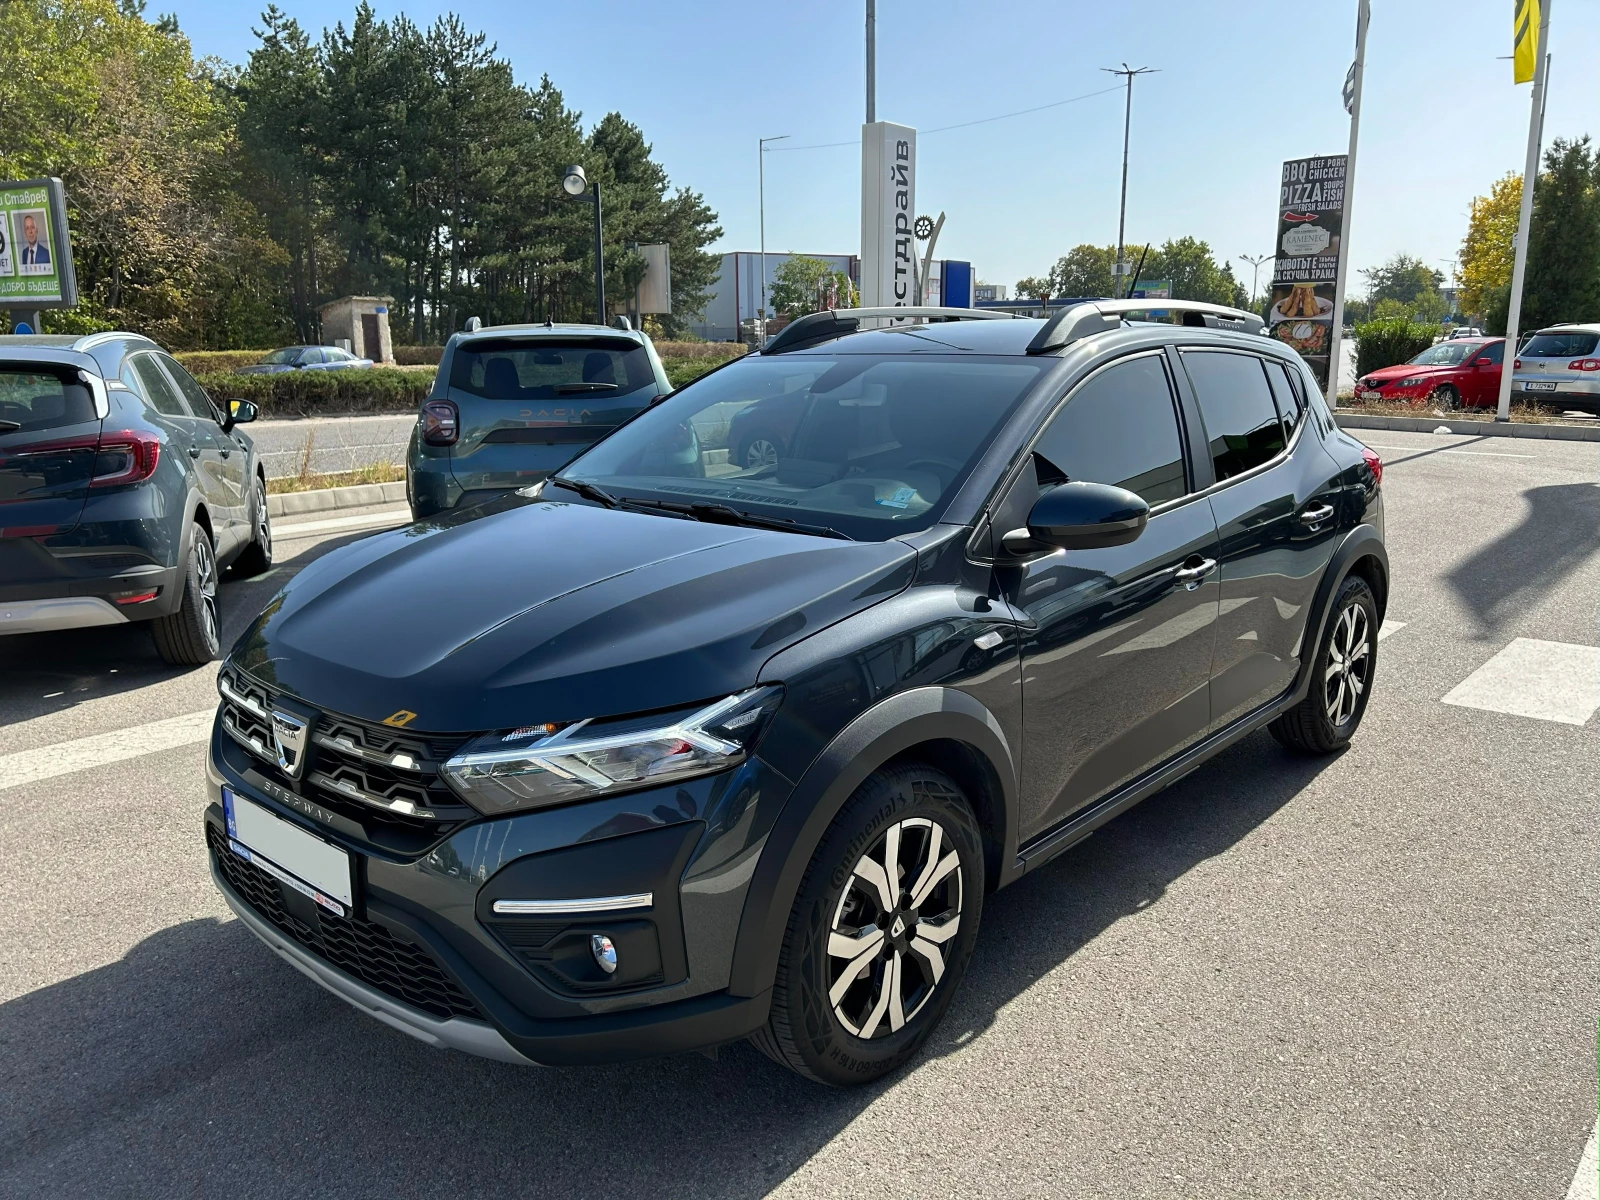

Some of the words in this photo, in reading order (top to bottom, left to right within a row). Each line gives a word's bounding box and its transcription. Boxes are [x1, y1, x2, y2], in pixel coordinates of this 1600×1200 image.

[1310, 160, 1325, 169] BEEF
[1327, 158, 1346, 167] PORK
[1283, 162, 1308, 183] BBQ
[1309, 167, 1345, 180] CHICKEN
[1323, 180, 1344, 190] SOUPS
[4, 189, 48, 207] Ставрев
[1280, 182, 1322, 205] PIZZA
[1323, 189, 1343, 202] FISH
[1298, 203, 1316, 212] FRESH
[1316, 201, 1342, 211] SALADS
[1286, 234, 1325, 244] KAMENEC
[1282, 269, 1310, 280] СКУЧНА
[1311, 269, 1336, 279] ХРАНА
[28, 281, 59, 293] БЪДЕЩЕ
[519, 408, 592, 417] DACIA
[275, 724, 298, 740] DACIA
[264, 781, 333, 823] STEPWAY
[831, 800, 897, 890] Continental
[830, 1046, 841, 1060] H
[838, 1053, 850, 1068] 16
[848, 1062, 857, 1072] R
[856, 1057, 893, 1074] 205/60
